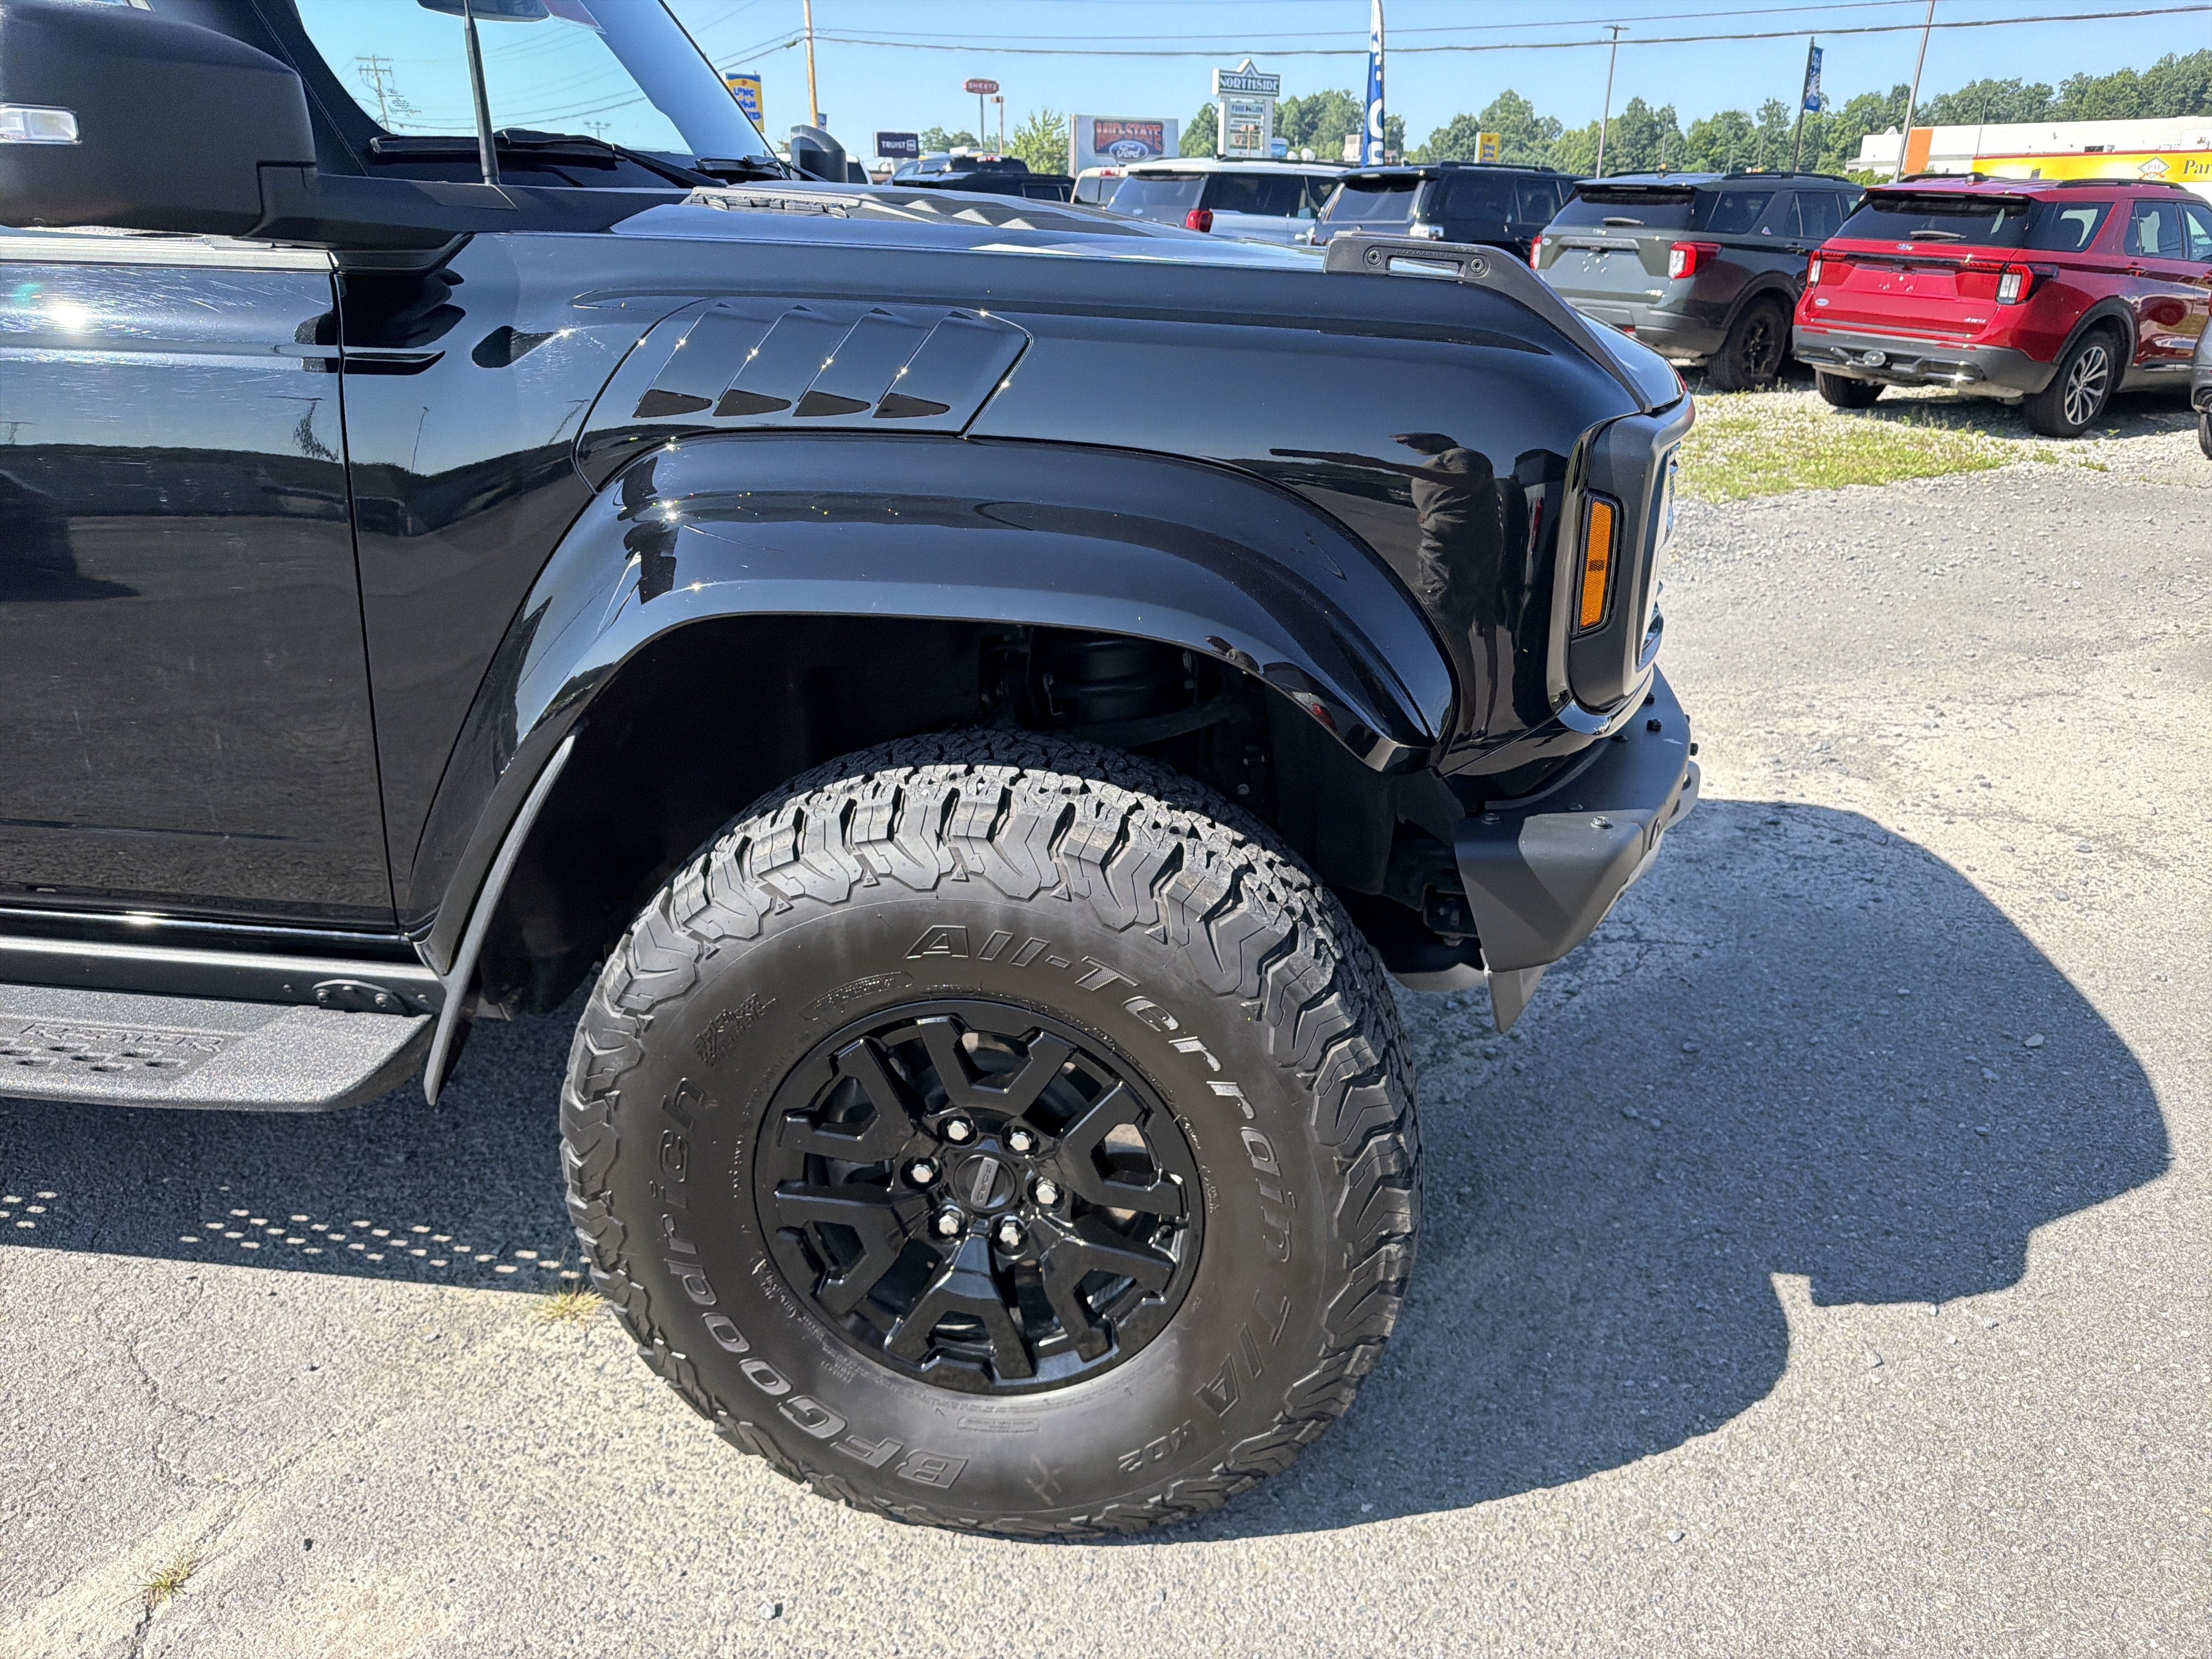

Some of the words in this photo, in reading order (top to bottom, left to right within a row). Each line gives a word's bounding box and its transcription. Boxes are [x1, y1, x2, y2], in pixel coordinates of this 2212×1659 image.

[1220, 77, 1279, 91] NORTHSIDE
[1116, 144, 1142, 158] Ford
[904, 926, 1296, 1263] All-Terrain
[977, 1164, 992, 1201] FORD
[649, 1077, 969, 1489] BFGoodrich
